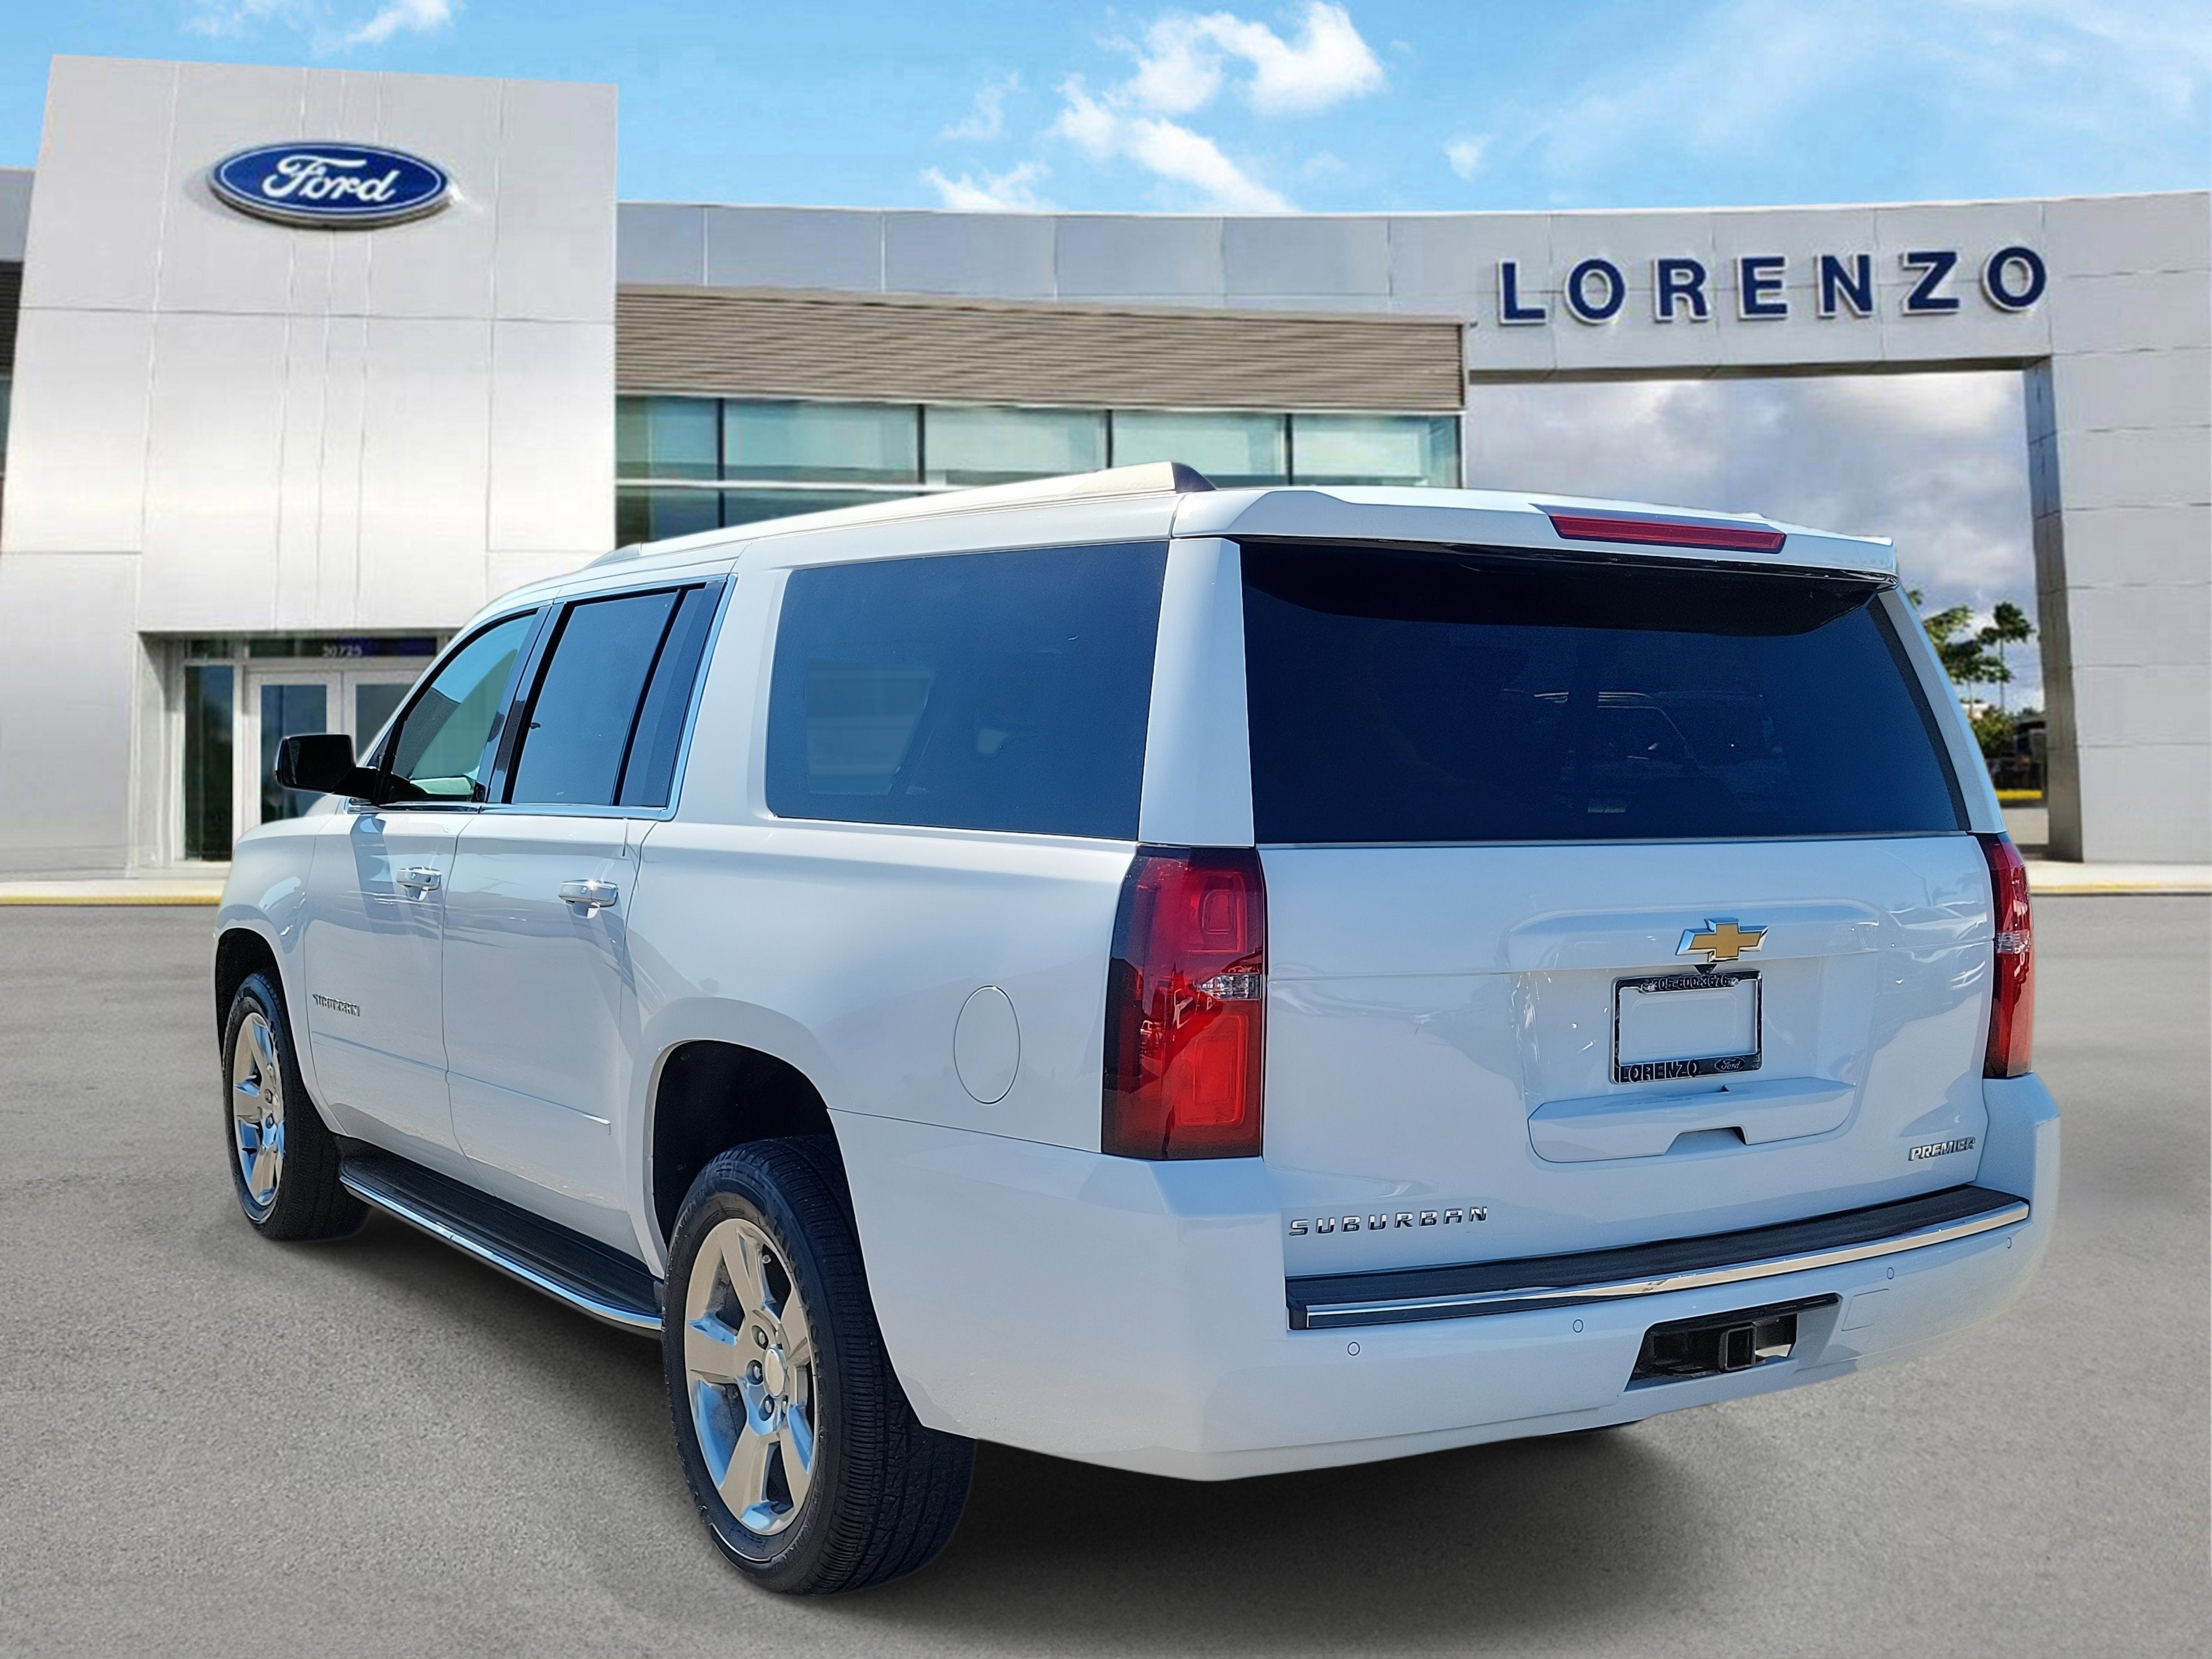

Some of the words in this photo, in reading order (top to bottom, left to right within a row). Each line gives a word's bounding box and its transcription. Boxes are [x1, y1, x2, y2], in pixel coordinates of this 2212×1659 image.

[261, 154, 400, 203] Ford
[1497, 246, 2048, 326] LORENZO
[1619, 1059, 1700, 1084] LORENZO
[1720, 1058, 1741, 1071] Ford
[1908, 1136, 1976, 1161] PREMIER
[1289, 1206, 1488, 1236] SUBURBAN
